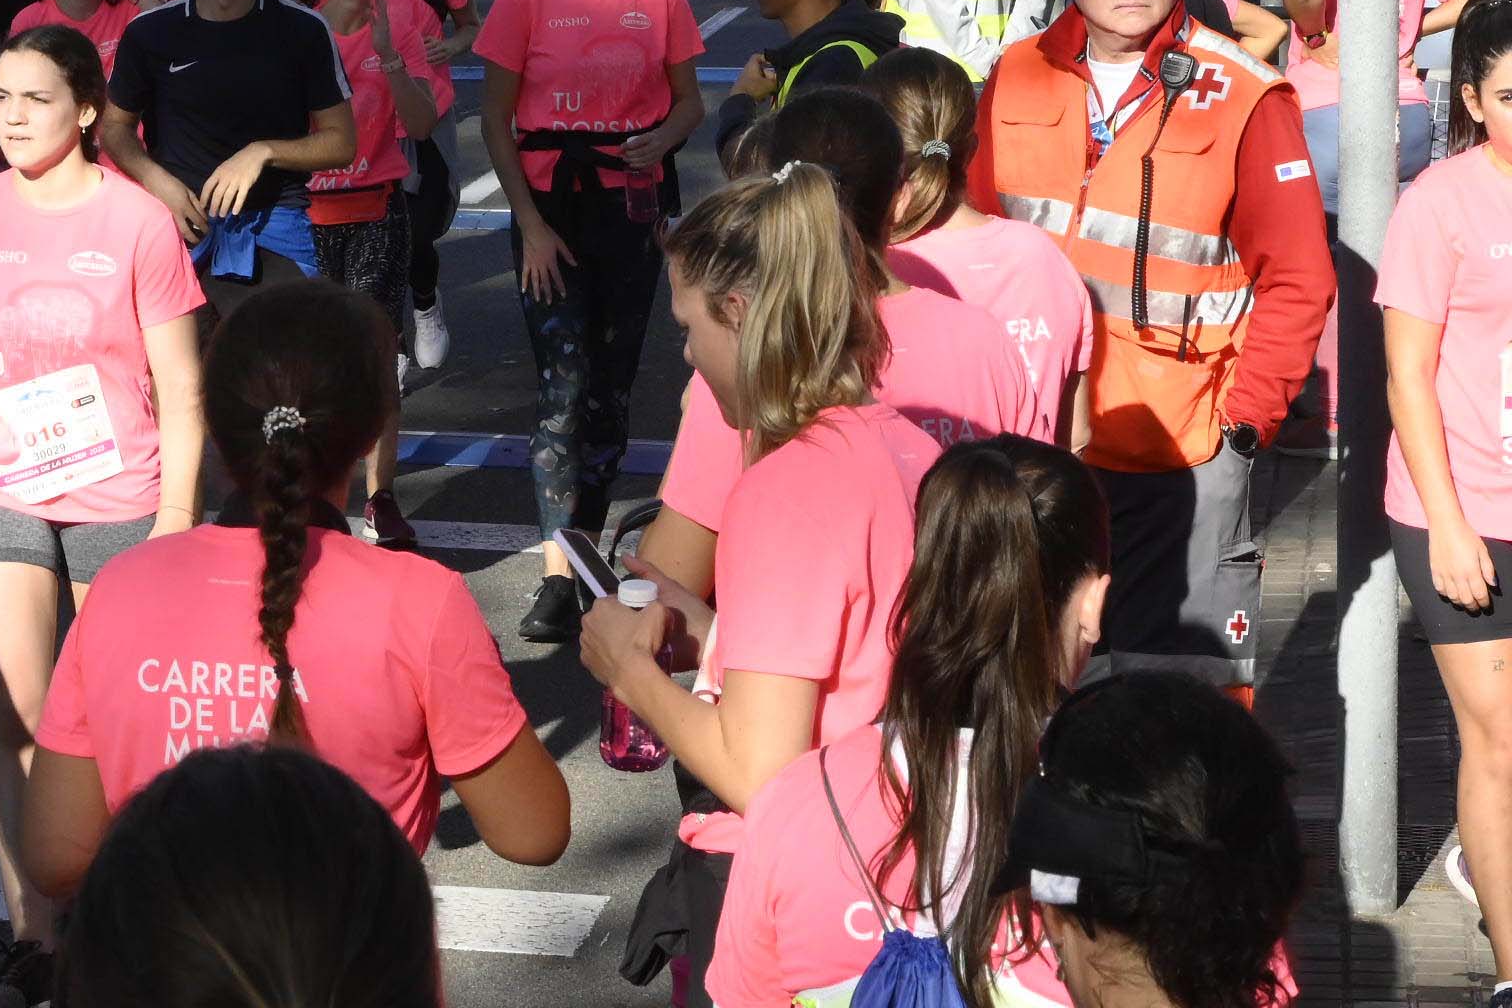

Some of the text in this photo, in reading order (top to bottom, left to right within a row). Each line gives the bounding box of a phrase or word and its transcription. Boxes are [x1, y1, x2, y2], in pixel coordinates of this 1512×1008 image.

[549, 17, 591, 28] OYSHO
[552, 92, 581, 111] TU
[24, 421, 66, 448] 016
[33, 442, 67, 463] 30029
[40, 464, 52, 473] DE
[51, 462, 63, 470] LA
[138, 658, 310, 703] CARRERA
[170, 696, 271, 736] DE LA
